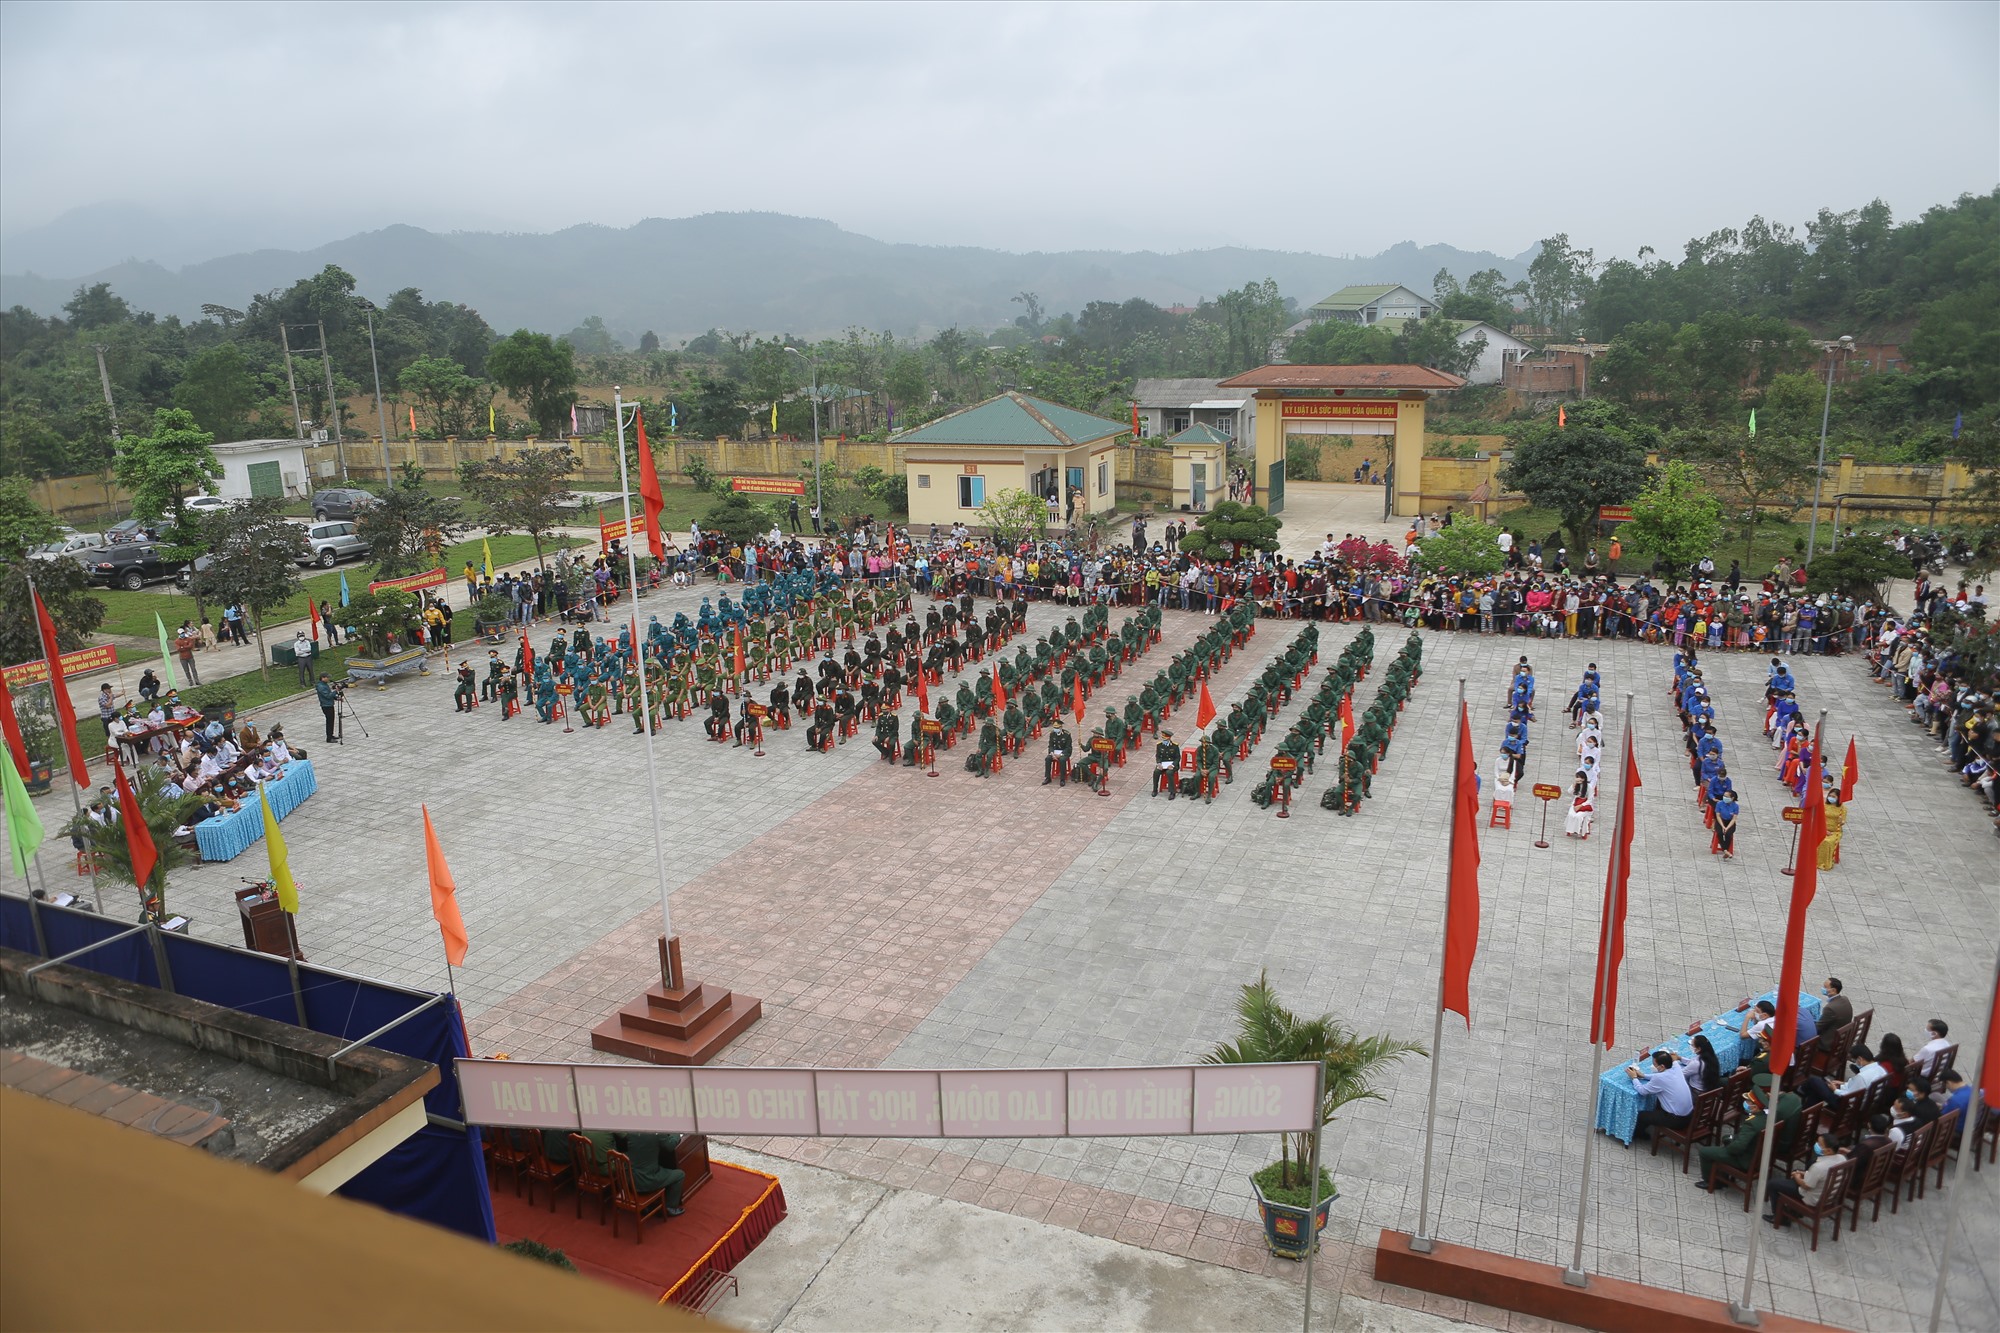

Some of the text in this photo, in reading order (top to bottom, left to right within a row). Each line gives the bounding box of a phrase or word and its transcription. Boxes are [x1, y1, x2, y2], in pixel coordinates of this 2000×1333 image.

[1294, 405, 1309, 416] LUẬT
[1310, 405, 1318, 414] LÀ
[1319, 404, 1331, 414] SỨC
[1333, 406, 1350, 416] MẠNH
[1352, 404, 1364, 414] CỦA
[1366, 406, 1382, 415] QUÂN
